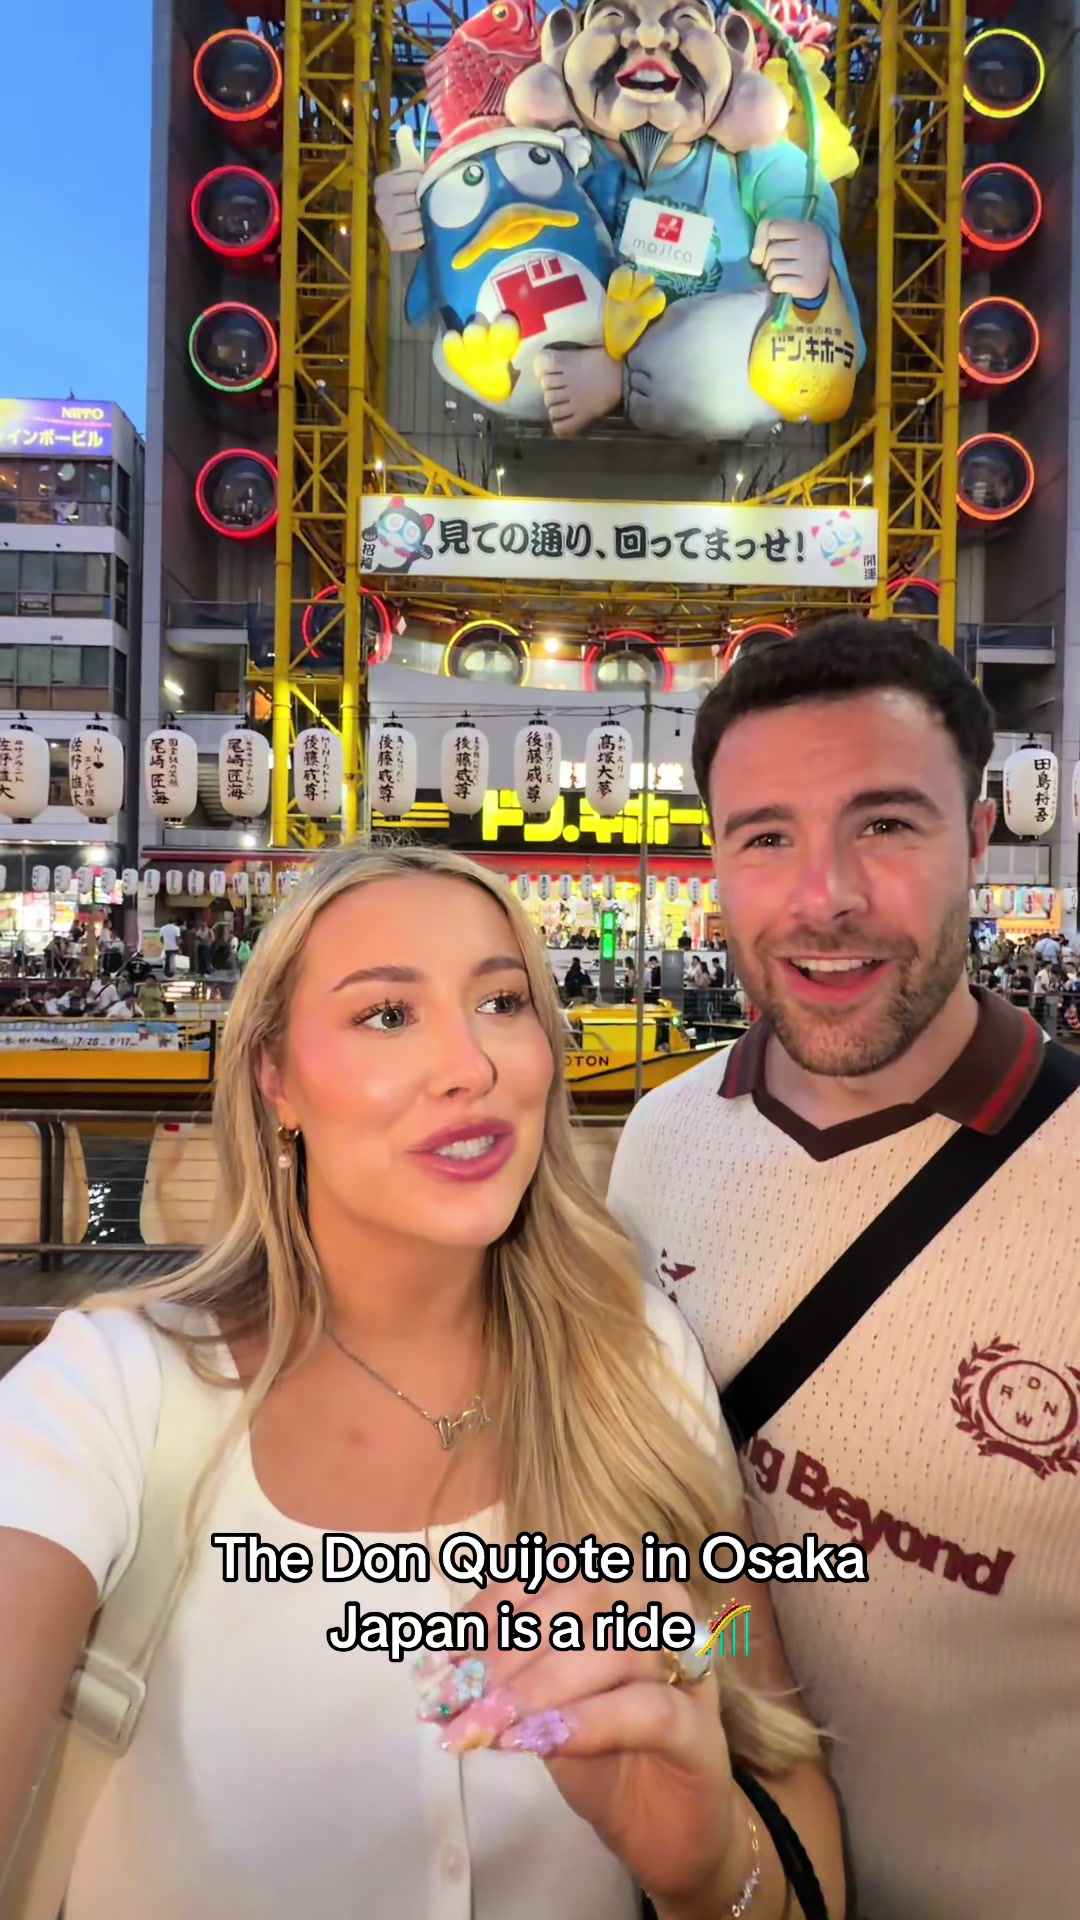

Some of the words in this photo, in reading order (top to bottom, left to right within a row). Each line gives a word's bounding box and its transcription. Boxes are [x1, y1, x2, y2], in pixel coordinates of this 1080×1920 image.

[0, 428, 104, 448] インボービル
[786, 1449, 1017, 1597] Beyond
